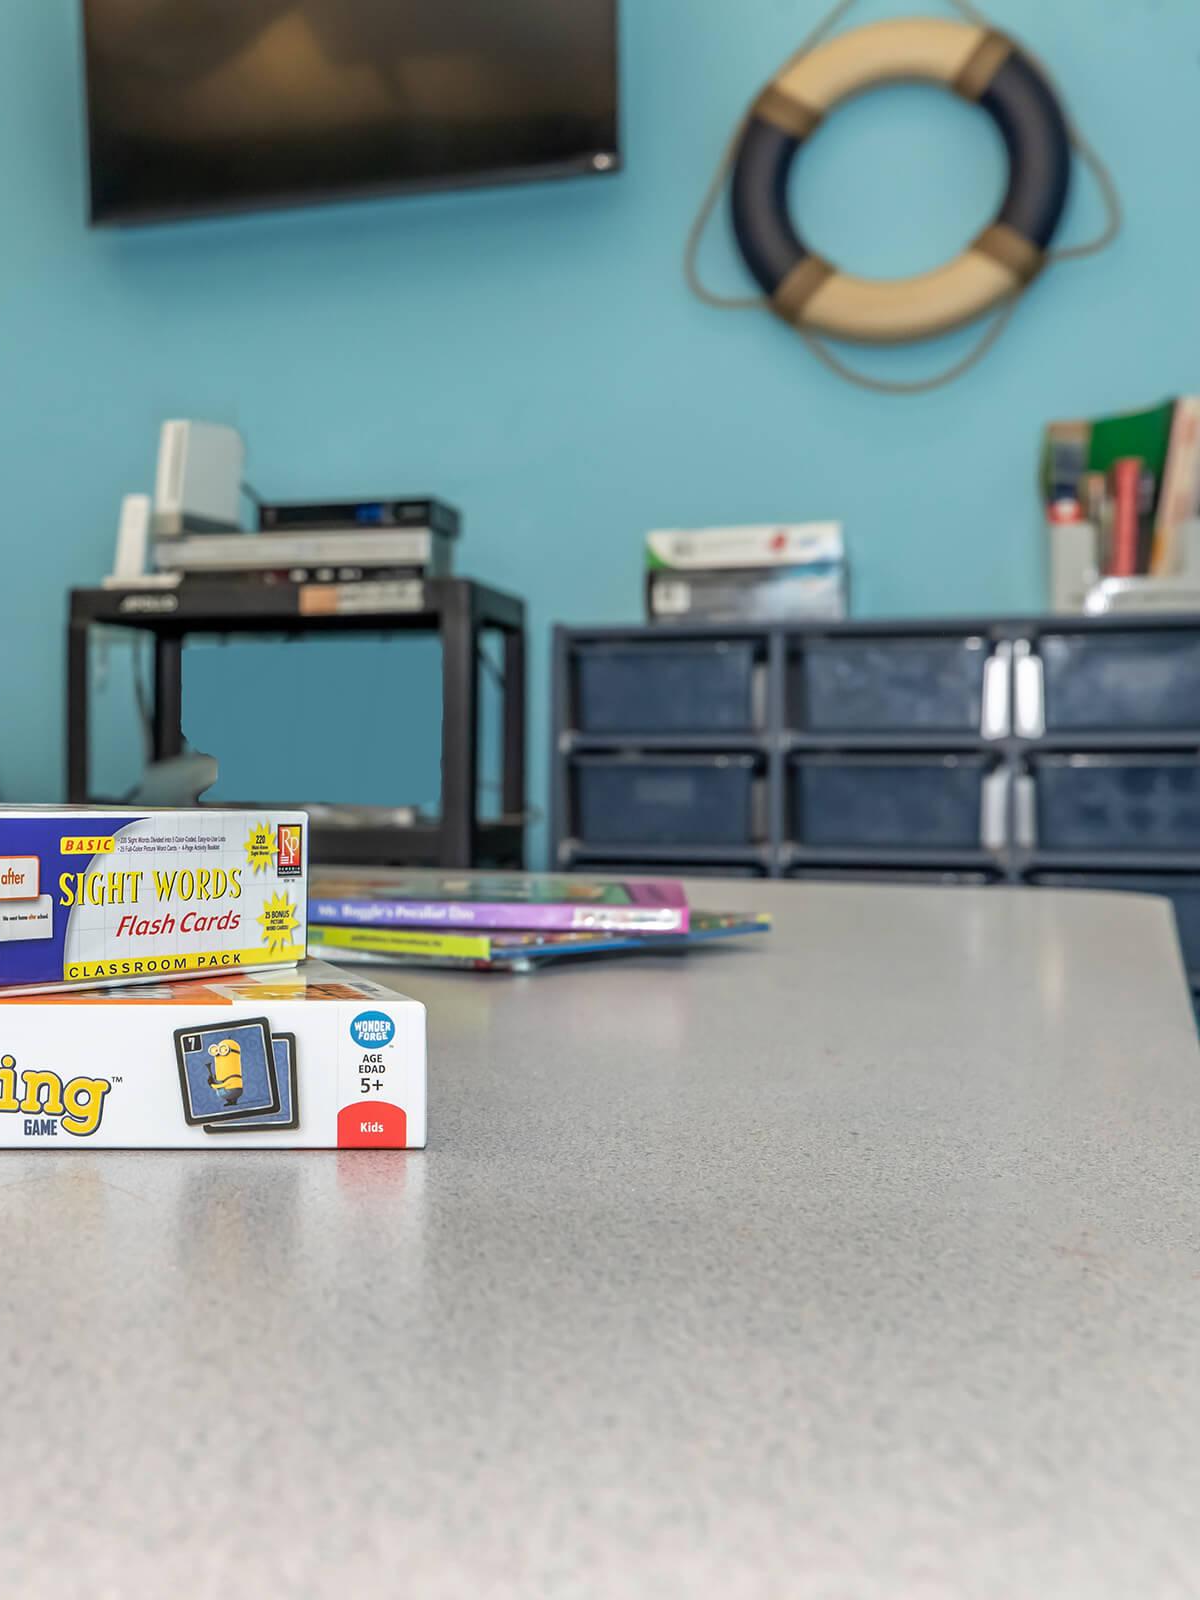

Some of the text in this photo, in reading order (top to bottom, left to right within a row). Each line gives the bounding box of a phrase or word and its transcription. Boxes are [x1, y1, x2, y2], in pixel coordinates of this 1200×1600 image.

[65, 840, 112, 851] BASIC
[256, 835, 266, 844] 220
[1, 868, 25, 885] after
[59, 868, 242, 907] SIGHT WORDS
[272, 911, 290, 919] BONUS
[116, 910, 241, 937] Flash Cards
[69, 953, 241, 979] CLASSROOM PACK
[354, 1020, 391, 1033] WONDER
[358, 1031, 388, 1042] FORGE
[188, 1037, 195, 1050] 7
[362, 1054, 383, 1064] AGE
[358, 1065, 385, 1074] EDAD
[360, 1078, 384, 1093] 5+
[24, 1119, 58, 1136] GAME
[360, 1122, 384, 1133] Kids
